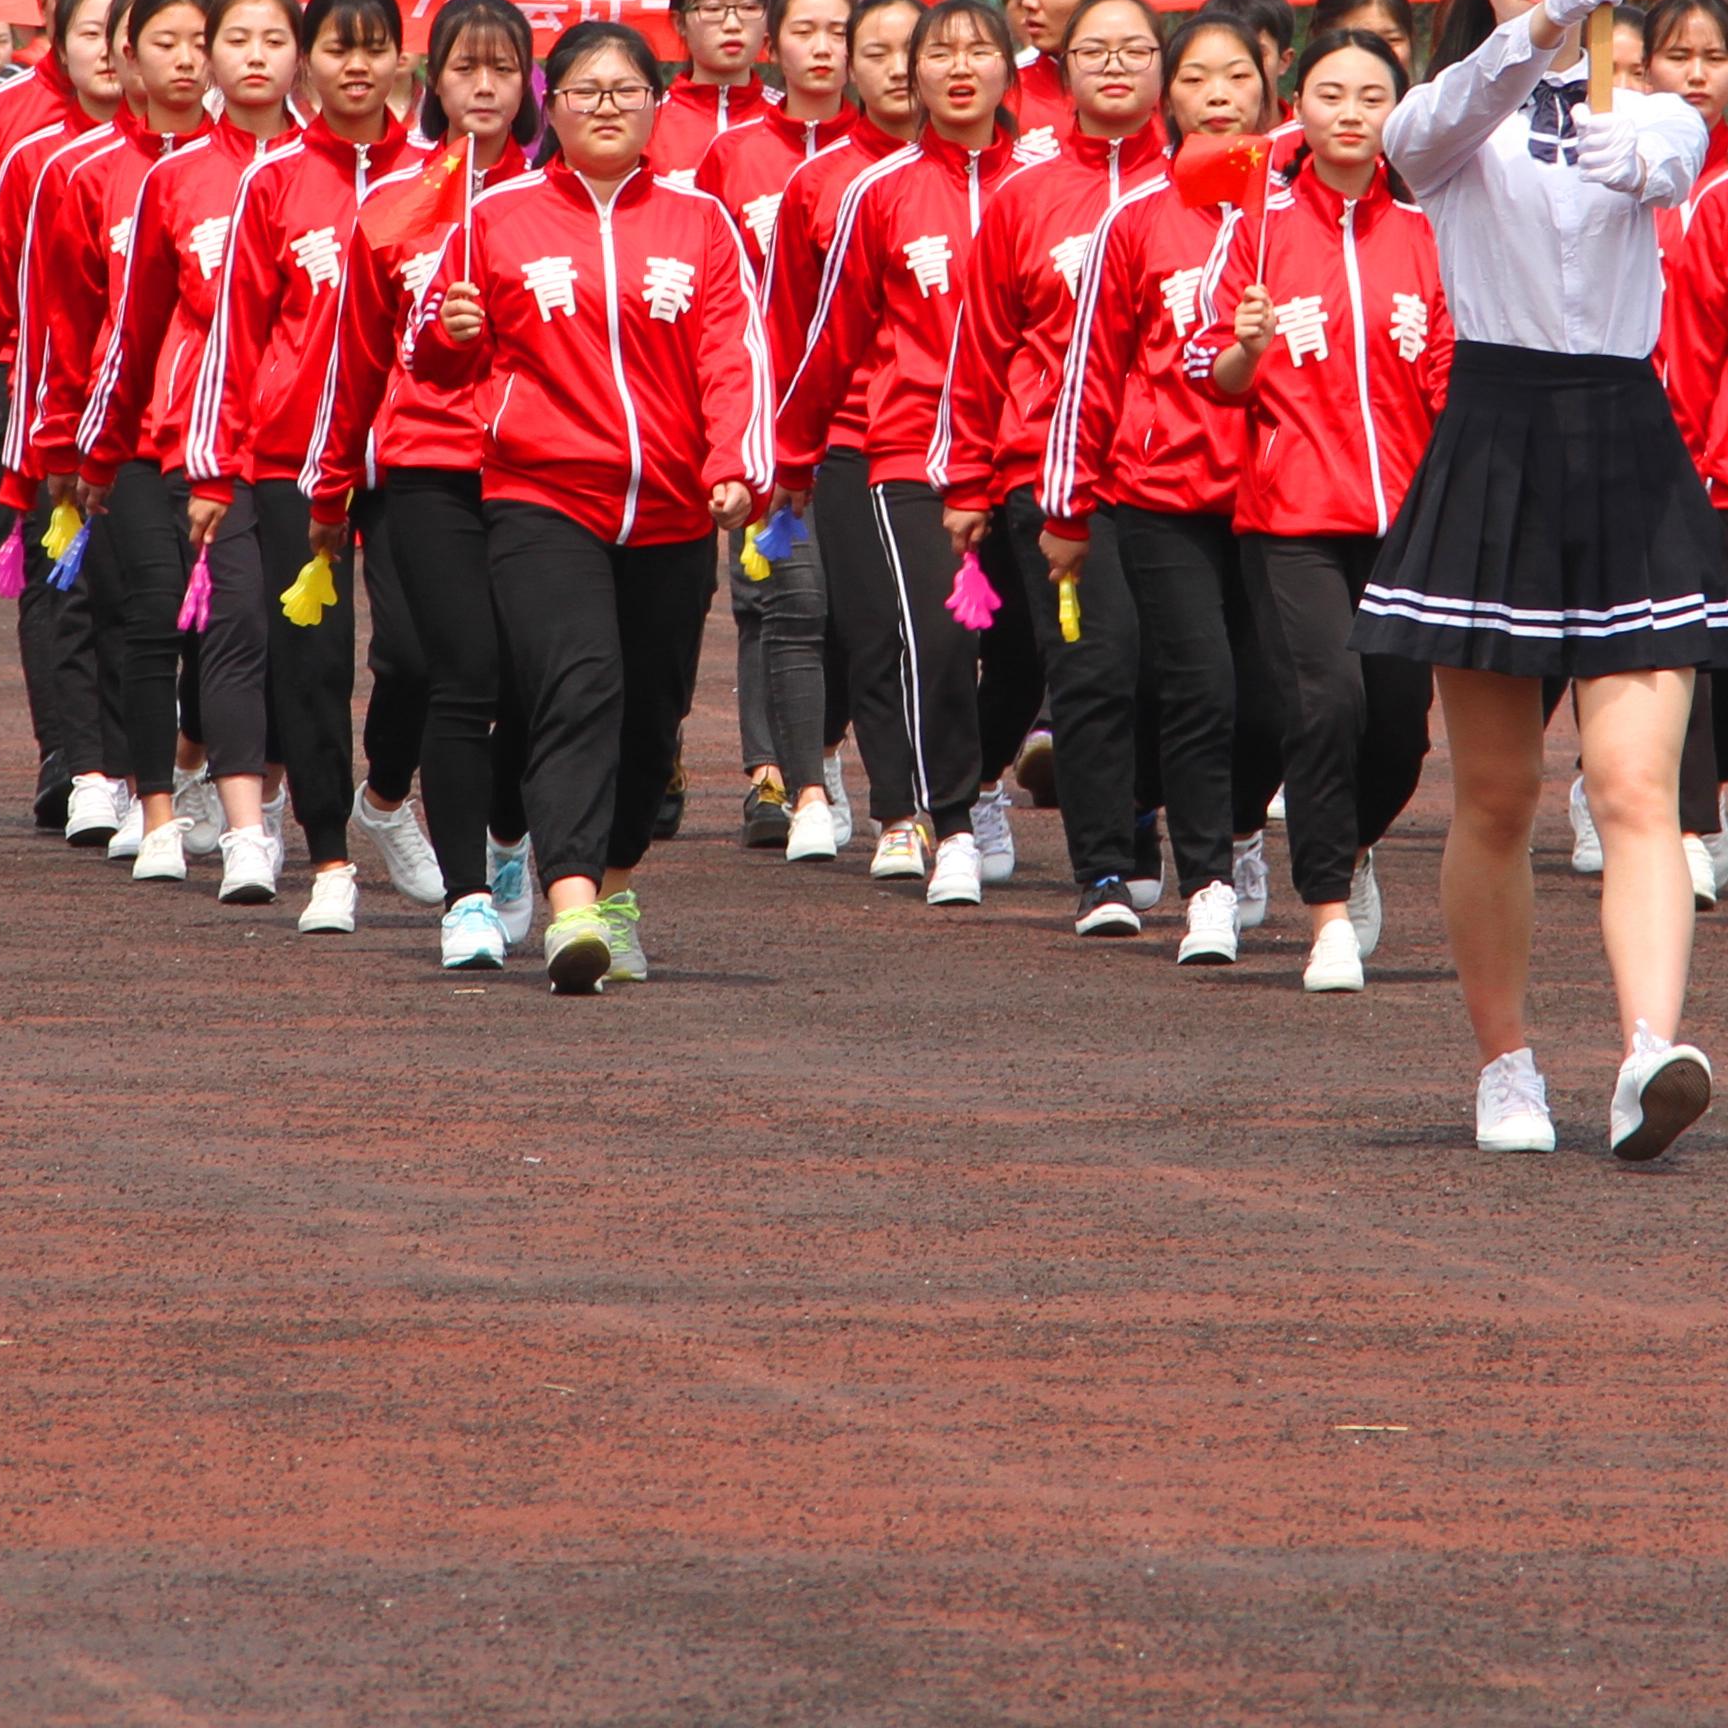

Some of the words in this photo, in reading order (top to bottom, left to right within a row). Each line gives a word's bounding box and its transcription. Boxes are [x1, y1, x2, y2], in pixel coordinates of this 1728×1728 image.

[290, 226, 342, 296] 青
[521, 256, 578, 323] 青
[641, 256, 696, 324] 春
[903, 235, 953, 299] 青
[1274, 295, 1329, 368] 青
[1389, 292, 1428, 363] 春
